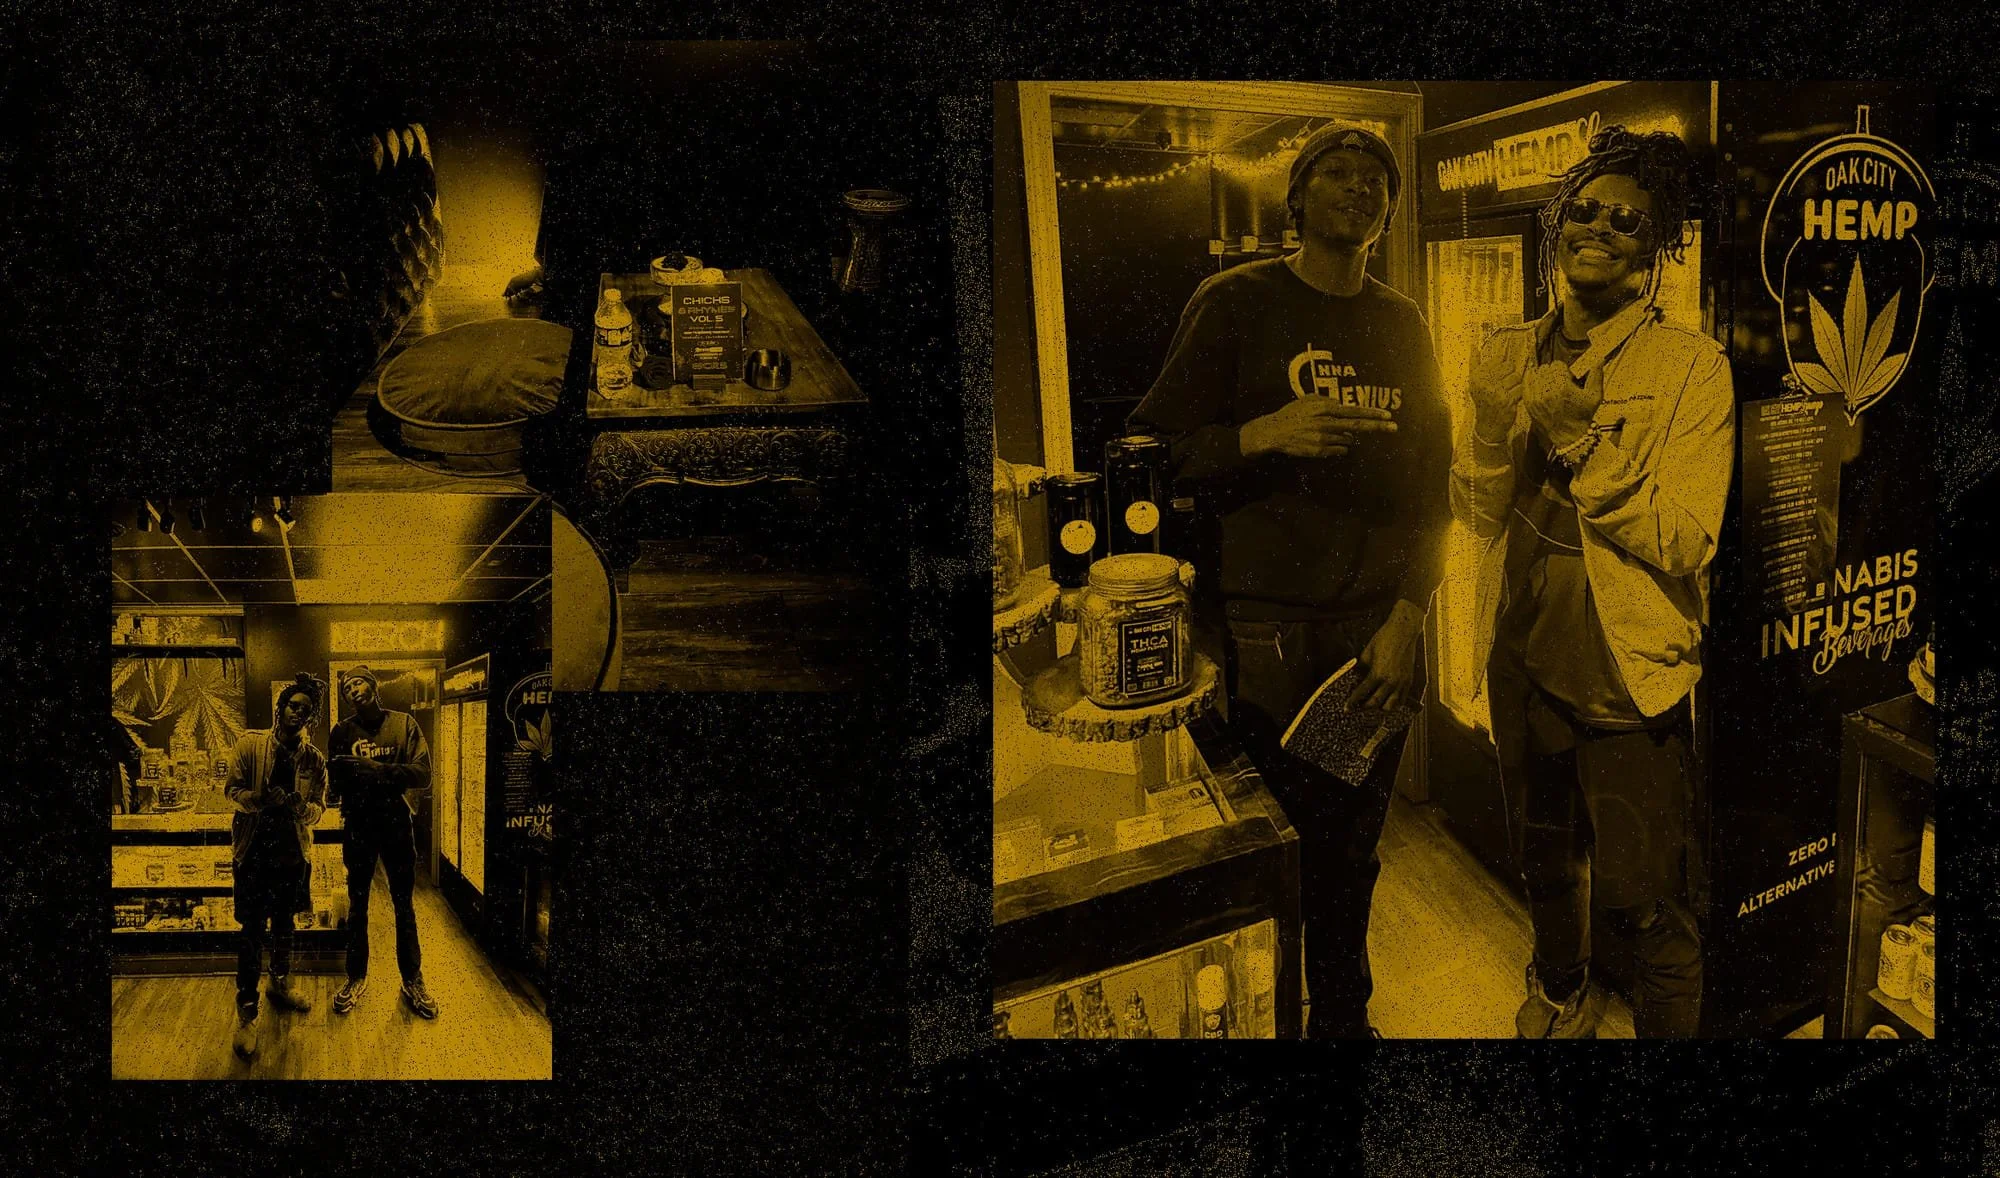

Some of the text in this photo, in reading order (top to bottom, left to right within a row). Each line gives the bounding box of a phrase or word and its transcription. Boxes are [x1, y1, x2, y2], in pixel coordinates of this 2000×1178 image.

[1498, 131, 1574, 180] HEMP
[1825, 157, 1897, 191] OAK CITY
[1803, 198, 1918, 240] HEMP
[1833, 548, 1918, 597] NABIS
[1130, 635, 1169, 650] THCA
[1762, 583, 1917, 658] INFUSED
[1812, 612, 1914, 675] Beverages
[522, 691, 552, 705] HE
[1788, 837, 1828, 867] ZERO
[1737, 859, 1836, 918] ALTERNATIVE
